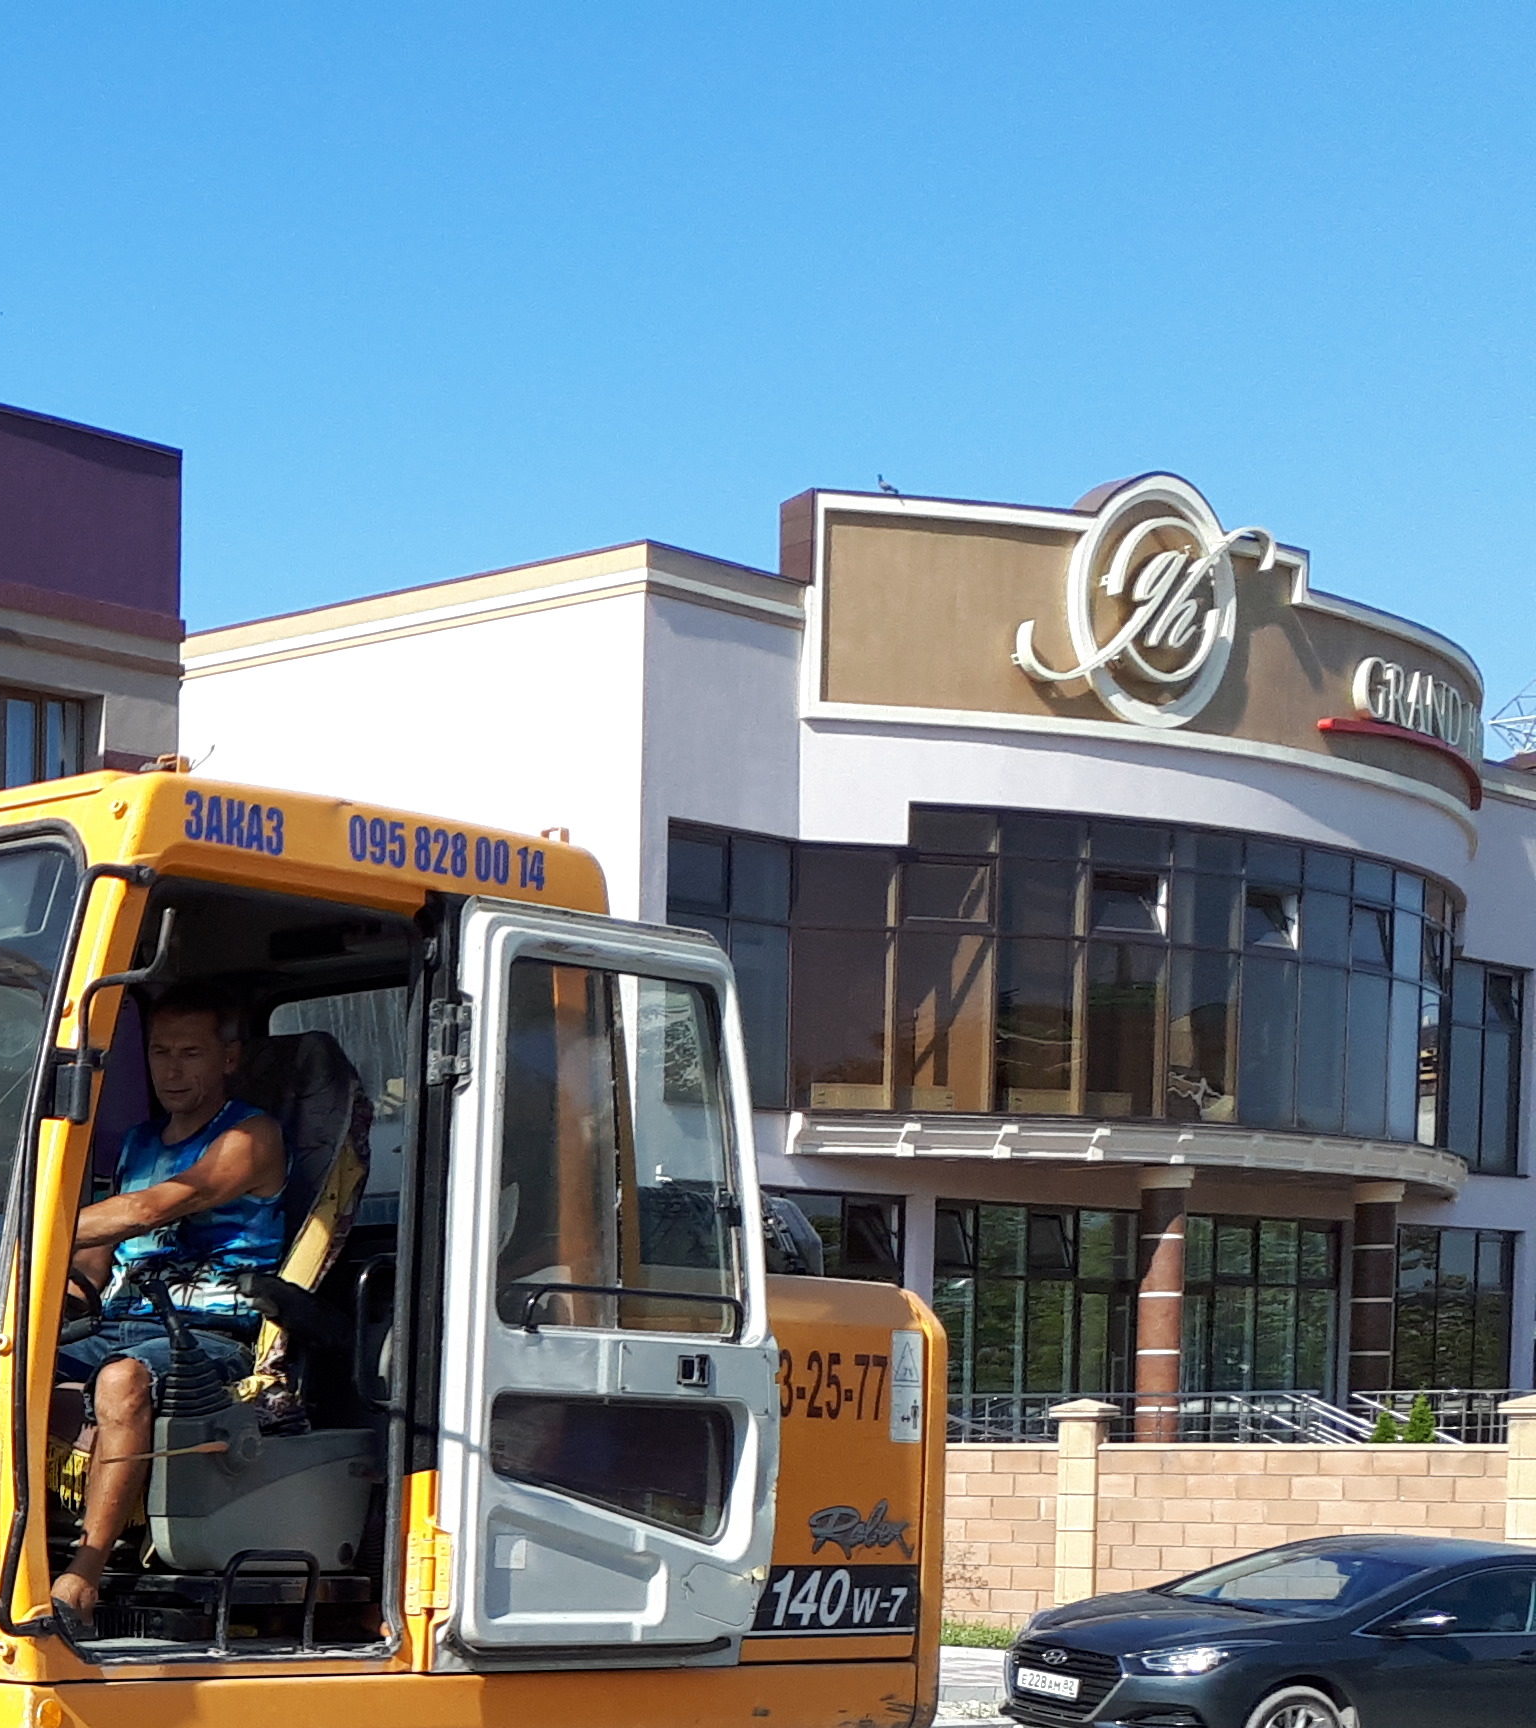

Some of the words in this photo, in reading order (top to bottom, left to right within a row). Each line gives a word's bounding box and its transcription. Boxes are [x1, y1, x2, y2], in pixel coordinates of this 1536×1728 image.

[1352, 656, 1463, 746] GRAND
[349, 814, 406, 868] 095
[414, 826, 468, 878] 828
[475, 836, 510, 886] 00
[516, 846, 545, 891] 14
